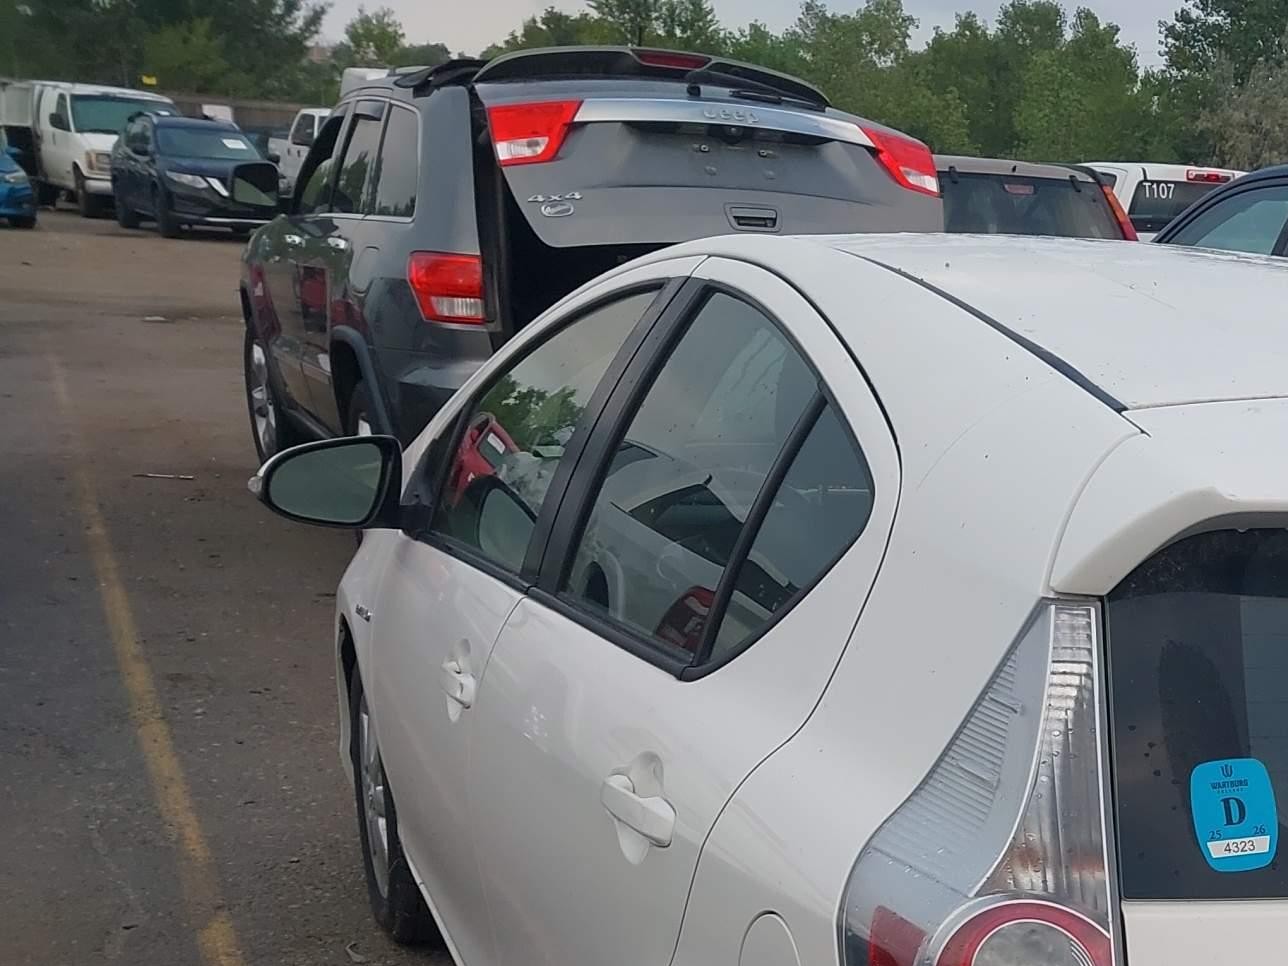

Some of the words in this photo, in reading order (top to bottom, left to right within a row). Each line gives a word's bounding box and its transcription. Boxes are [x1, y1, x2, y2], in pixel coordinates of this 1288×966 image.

[528, 191, 583, 202] 4x4
[1143, 182, 1175, 199] T107
[1221, 797, 1247, 827] D
[1208, 830, 1222, 840] 25
[1253, 825, 1266, 835] 26
[1223, 840, 1256, 854] 4323
